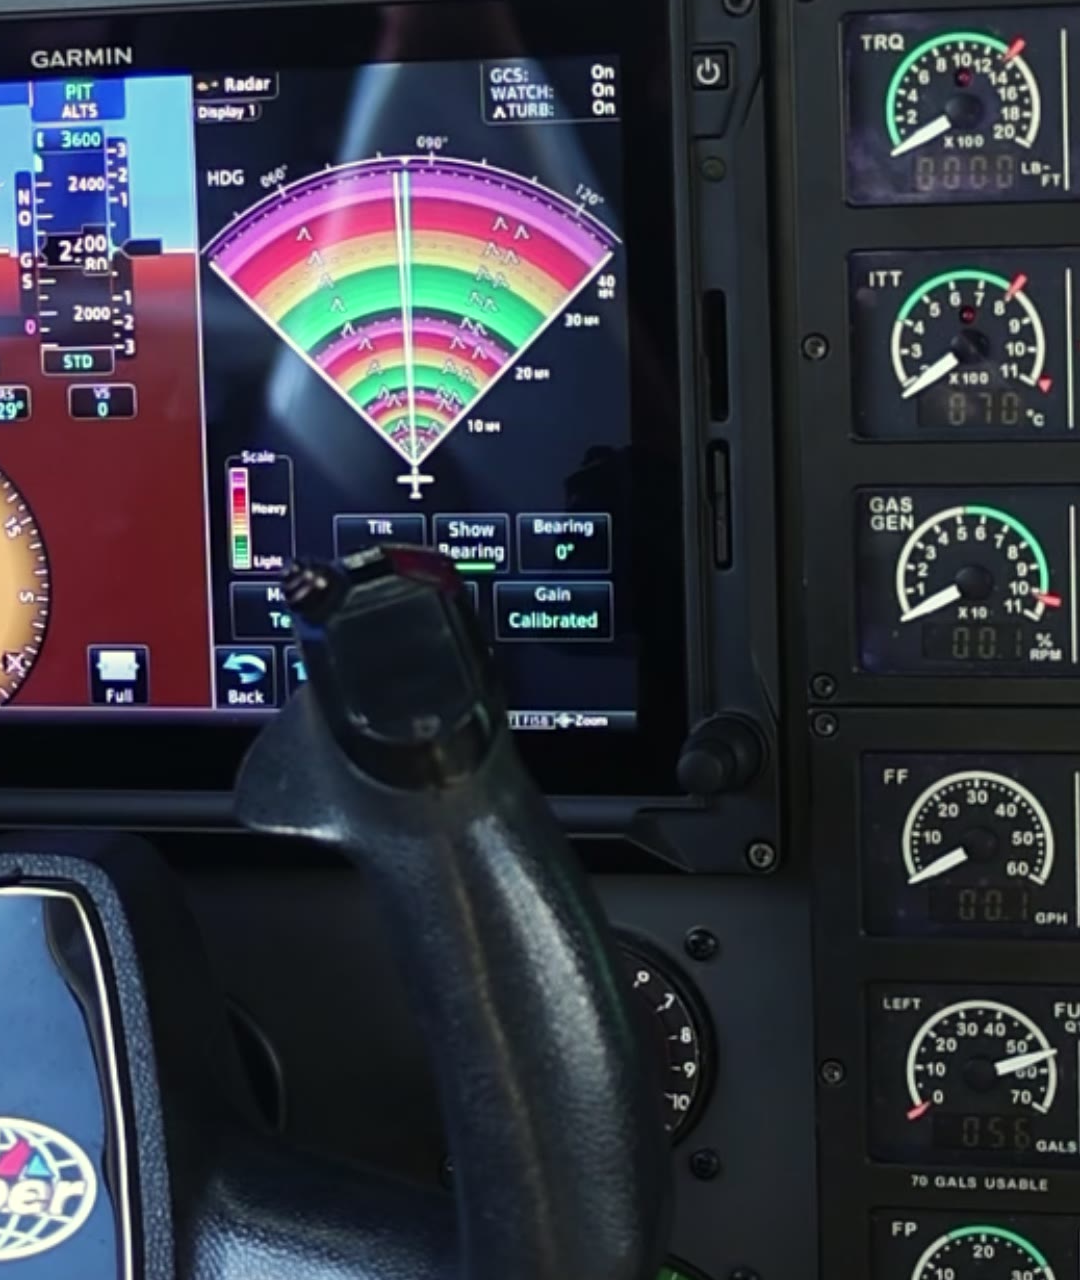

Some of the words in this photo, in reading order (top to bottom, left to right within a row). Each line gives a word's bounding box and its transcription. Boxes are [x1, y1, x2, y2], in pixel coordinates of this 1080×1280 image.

[861, 34, 905, 51] TRQ
[31, 47, 133, 69] GARMIN
[490, 68, 529, 84] GCS:
[591, 64, 615, 80] On
[65, 83, 93, 100] PIT
[224, 76, 271, 94] Radar
[490, 87, 554, 102] WATCH:
[592, 82, 615, 98] On
[62, 103, 98, 119] ALTS
[197, 105, 244, 121] Display
[248, 104, 256, 119] 1
[592, 100, 615, 115] On
[61, 130, 101, 148] 3600
[68, 175, 105, 192] 2400
[207, 170, 244, 187] HDG
[869, 271, 902, 287] ITT
[63, 354, 93, 369] STD
[870, 497, 913, 513] GAS
[368, 521, 393, 536] Tilt
[449, 522, 496, 538] Show
[534, 521, 594, 539] Bearing
[871, 515, 914, 531] GEN
[535, 588, 571, 602] Gain
[509, 614, 598, 628] Calibrated
[1030, 649, 1062, 661] RPM
[106, 689, 134, 703] Full
[228, 691, 264, 706] Back
[883, 769, 908, 784] FF
[1035, 913, 1068, 924] GPH
[883, 998, 921, 1010] LEFT
[1036, 1140, 1077, 1153] GALS
[912, 1175, 928, 1187] 70
[934, 1177, 977, 1189] GALS
[984, 1177, 1048, 1191] USABLE
[892, 1222, 917, 1237] FP
